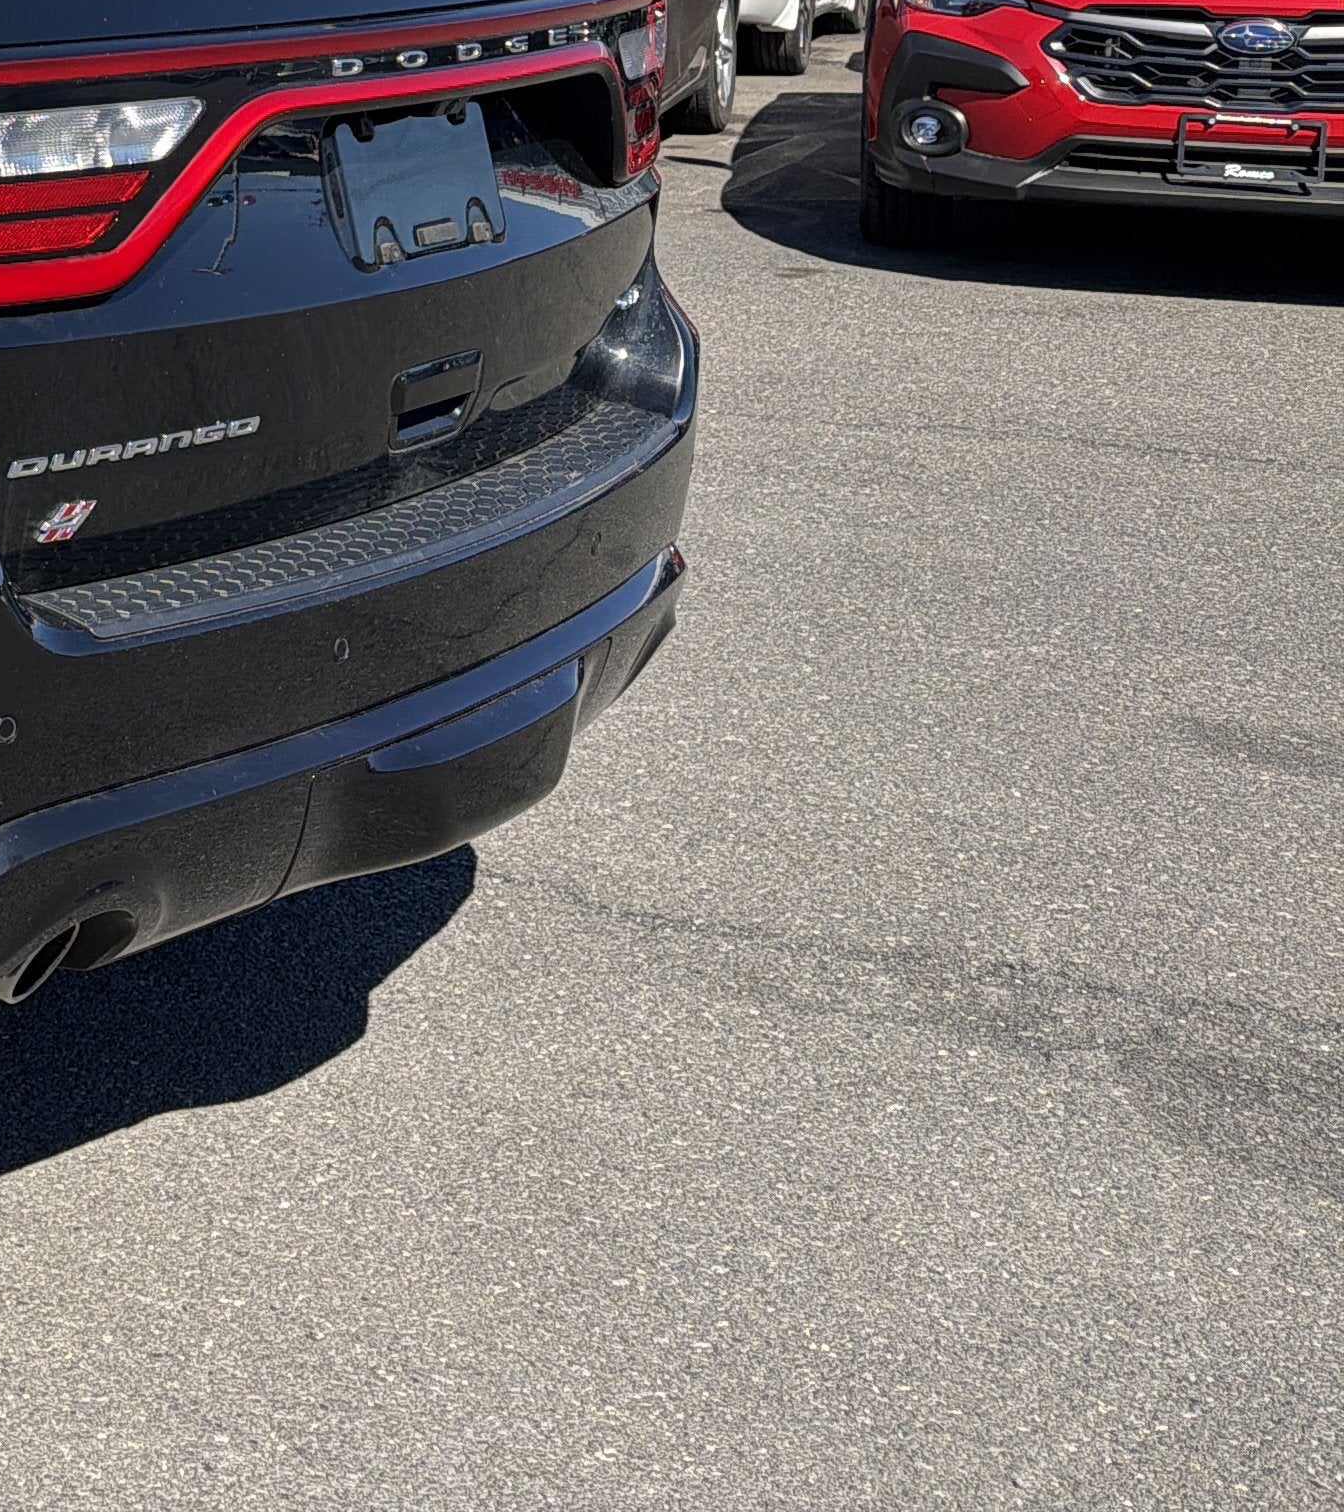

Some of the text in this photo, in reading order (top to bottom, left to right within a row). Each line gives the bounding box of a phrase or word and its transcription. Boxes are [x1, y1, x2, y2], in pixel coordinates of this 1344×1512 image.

[331, 28, 568, 77] DODGE
[1223, 163, 1274, 180] Romeo
[7, 415, 261, 479] DURANGO
